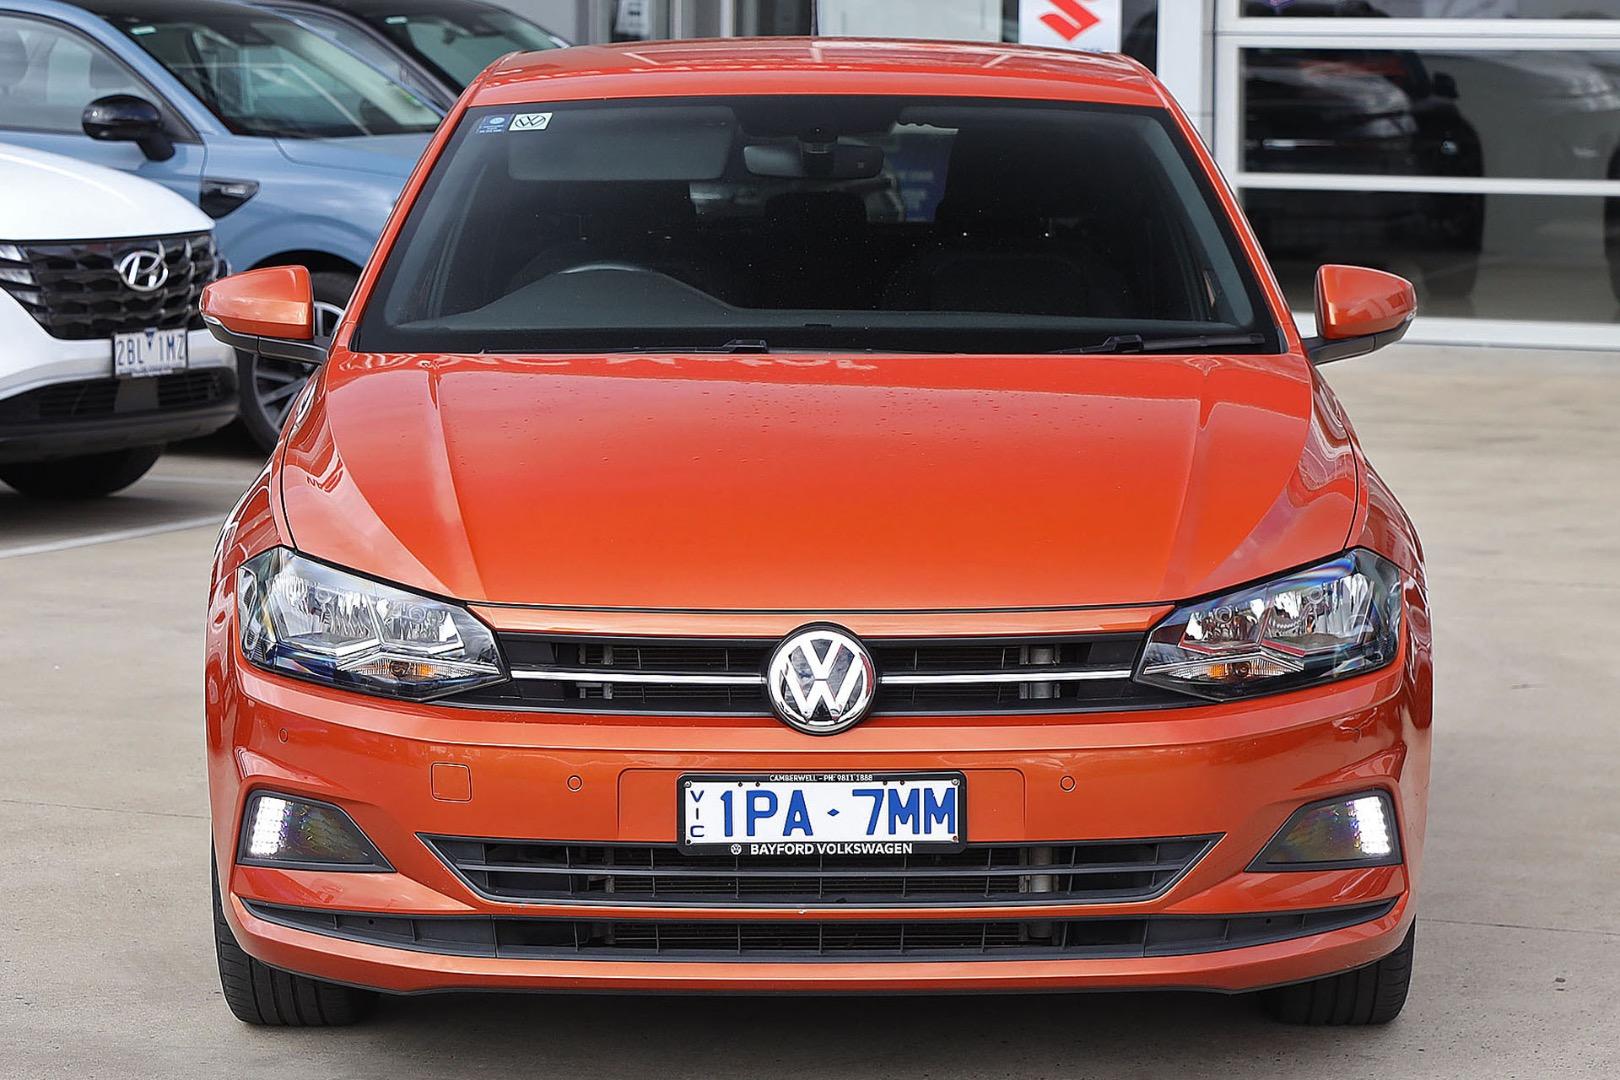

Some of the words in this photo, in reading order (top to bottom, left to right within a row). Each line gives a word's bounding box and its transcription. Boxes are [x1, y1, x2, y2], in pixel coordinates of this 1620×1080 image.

[769, 774, 817, 782] CAMBERWELL
[837, 774, 855, 782] 9811
[720, 789, 814, 837] 1PA
[852, 787, 956, 836] 7MM
[750, 843, 814, 855] BAYFORD
[817, 842, 913, 855] VOLKSWAGEN
